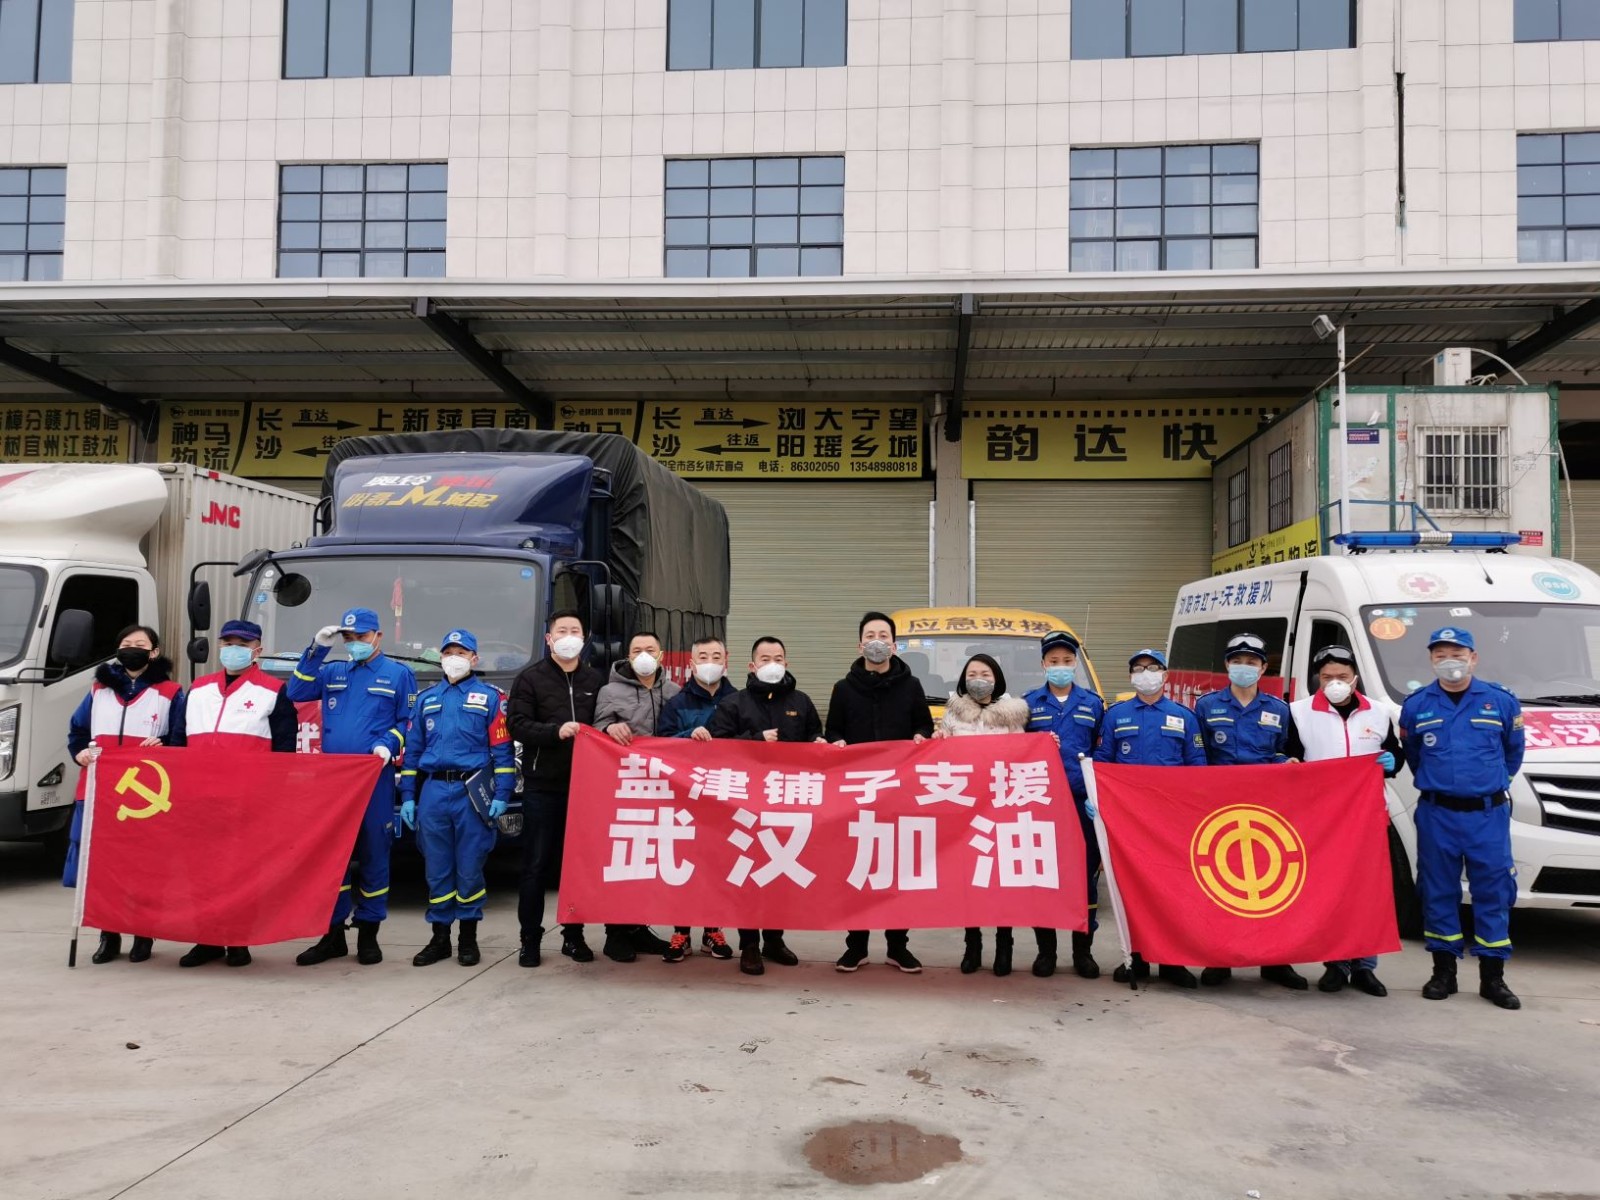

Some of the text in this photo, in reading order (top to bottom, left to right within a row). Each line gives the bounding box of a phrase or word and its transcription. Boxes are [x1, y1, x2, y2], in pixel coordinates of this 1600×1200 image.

[299, 408, 328, 422] 直达
[702, 408, 733, 420] 直达
[171, 422, 231, 446] 神马
[255, 408, 283, 460] 长沙
[651, 407, 681, 457] 长沙
[727, 433, 760, 447] 往返
[986, 423, 1269, 462] 韵达快
[790, 460, 840, 472] 86302050
[850, 460, 918, 472] 13548980818
[202, 500, 241, 529] JMC
[1178, 580, 1274, 615] 浏阳市红十天救援队
[908, 617, 1053, 633] 应急救援
[614, 753, 1052, 807] 盐津铺子支援
[603, 806, 1060, 890] 武汉加油
